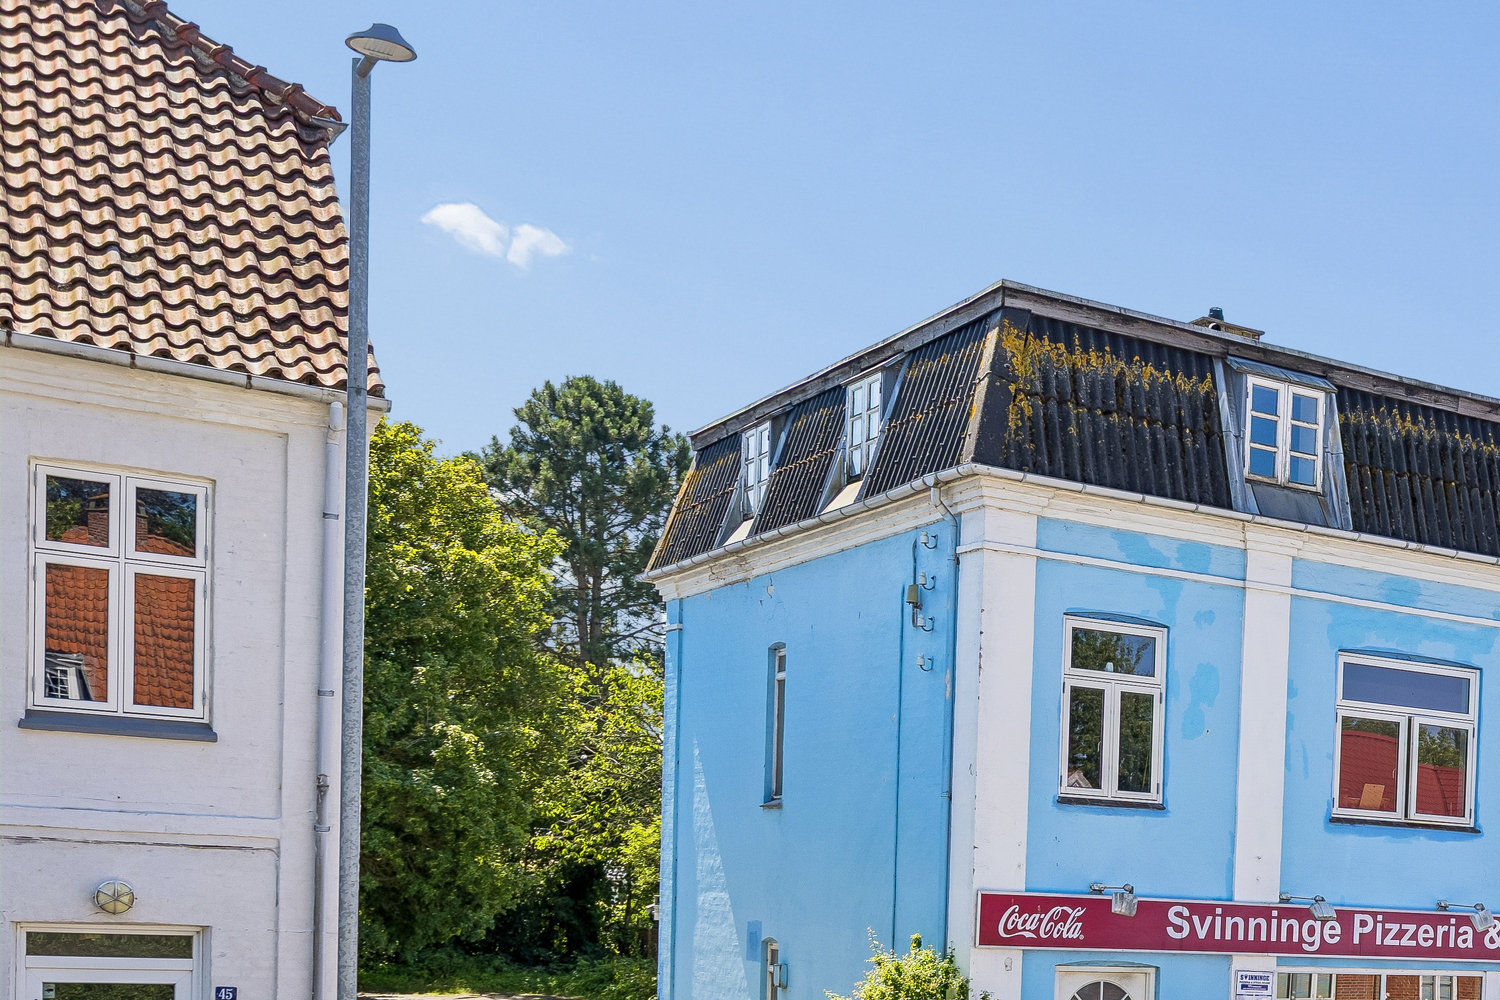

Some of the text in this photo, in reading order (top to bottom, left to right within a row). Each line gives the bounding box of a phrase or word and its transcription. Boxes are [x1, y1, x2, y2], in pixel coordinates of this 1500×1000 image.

[998, 904, 1086, 939] Coca-Cola
[1166, 905, 1341, 951] Svinninge
[1353, 913, 1473, 949] Pizzeria
[218, 988, 233, 1000] 45
